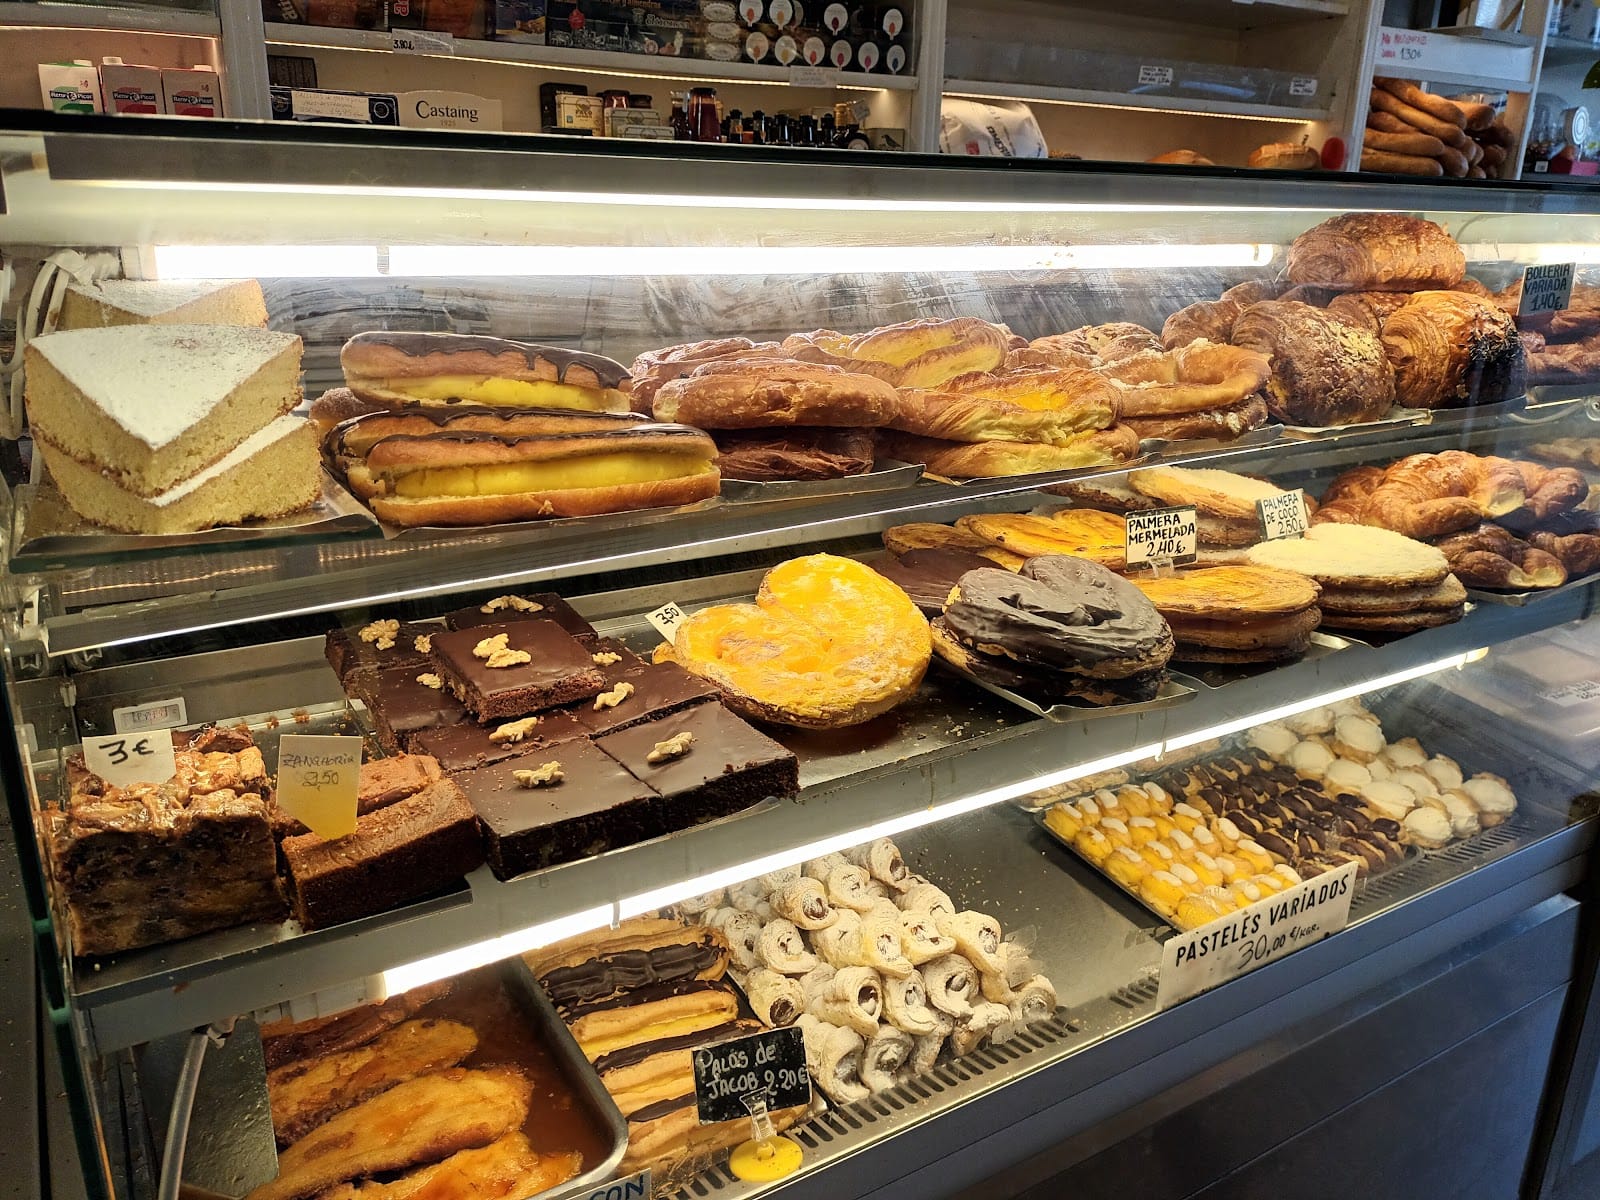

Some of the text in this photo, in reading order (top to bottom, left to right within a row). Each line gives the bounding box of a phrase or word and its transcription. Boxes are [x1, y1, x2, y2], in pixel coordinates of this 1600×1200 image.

[416, 100, 479, 122] Castaing
[1526, 263, 1570, 281] BOLLERIA
[1525, 278, 1567, 295] VARIADA
[1263, 493, 1299, 511] PALMERA
[1128, 514, 1181, 533] PALMERA
[1266, 505, 1298, 524] DE COCO
[1128, 522, 1195, 546] MERMELADA
[1269, 873, 1349, 926] VARIADOS
[755, 1041, 777, 1066] de
[706, 1071, 759, 1100] JACOB
